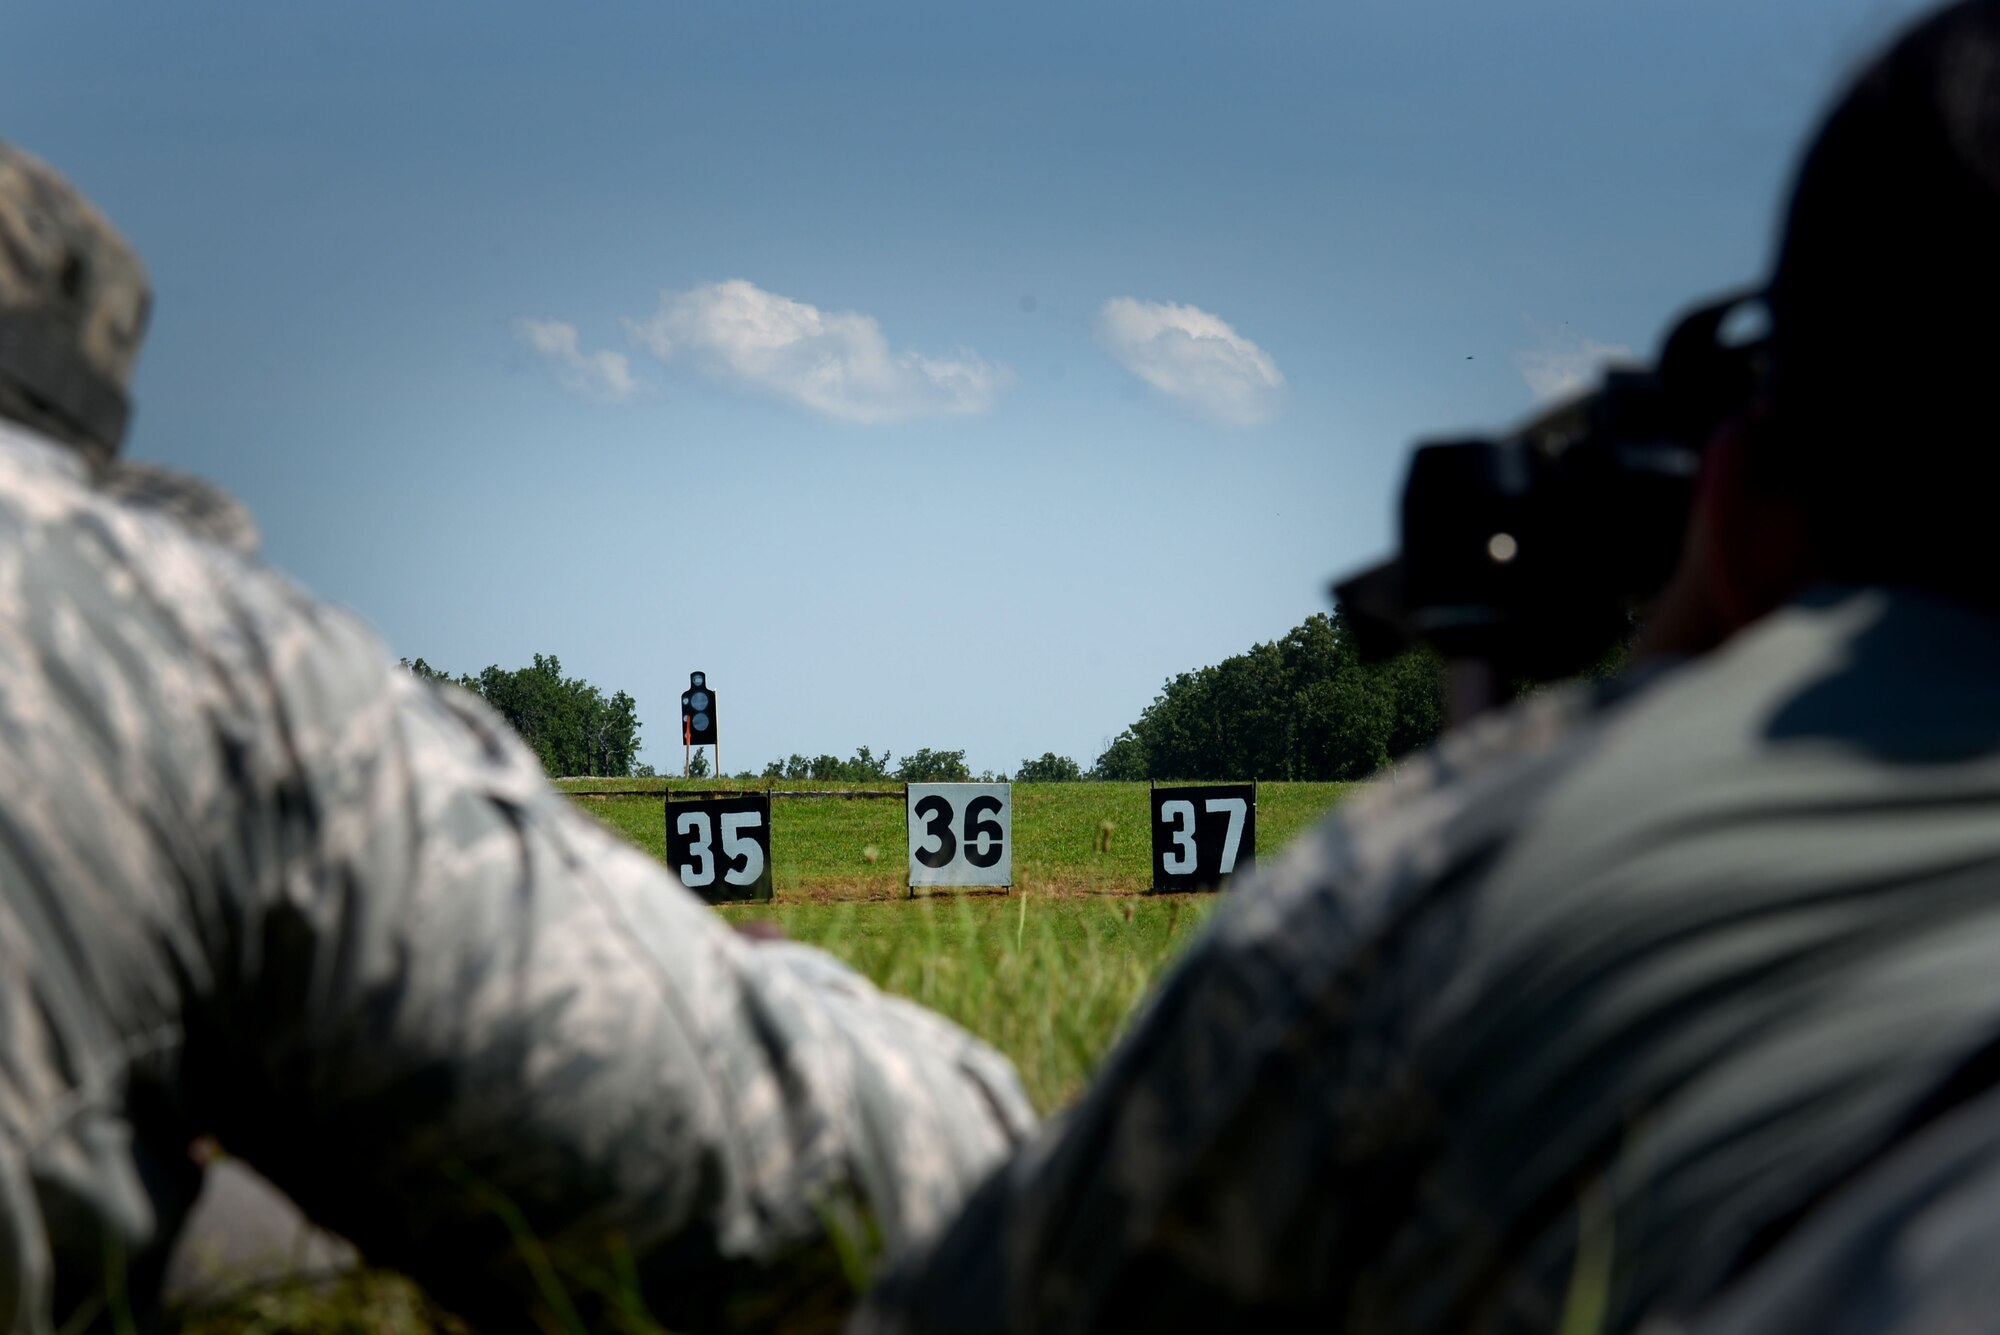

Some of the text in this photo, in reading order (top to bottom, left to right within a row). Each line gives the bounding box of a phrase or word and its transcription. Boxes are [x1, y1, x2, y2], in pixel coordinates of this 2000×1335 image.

[677, 811, 764, 887] 35
[914, 795, 1003, 868] 36
[1161, 798, 1247, 875] 37
